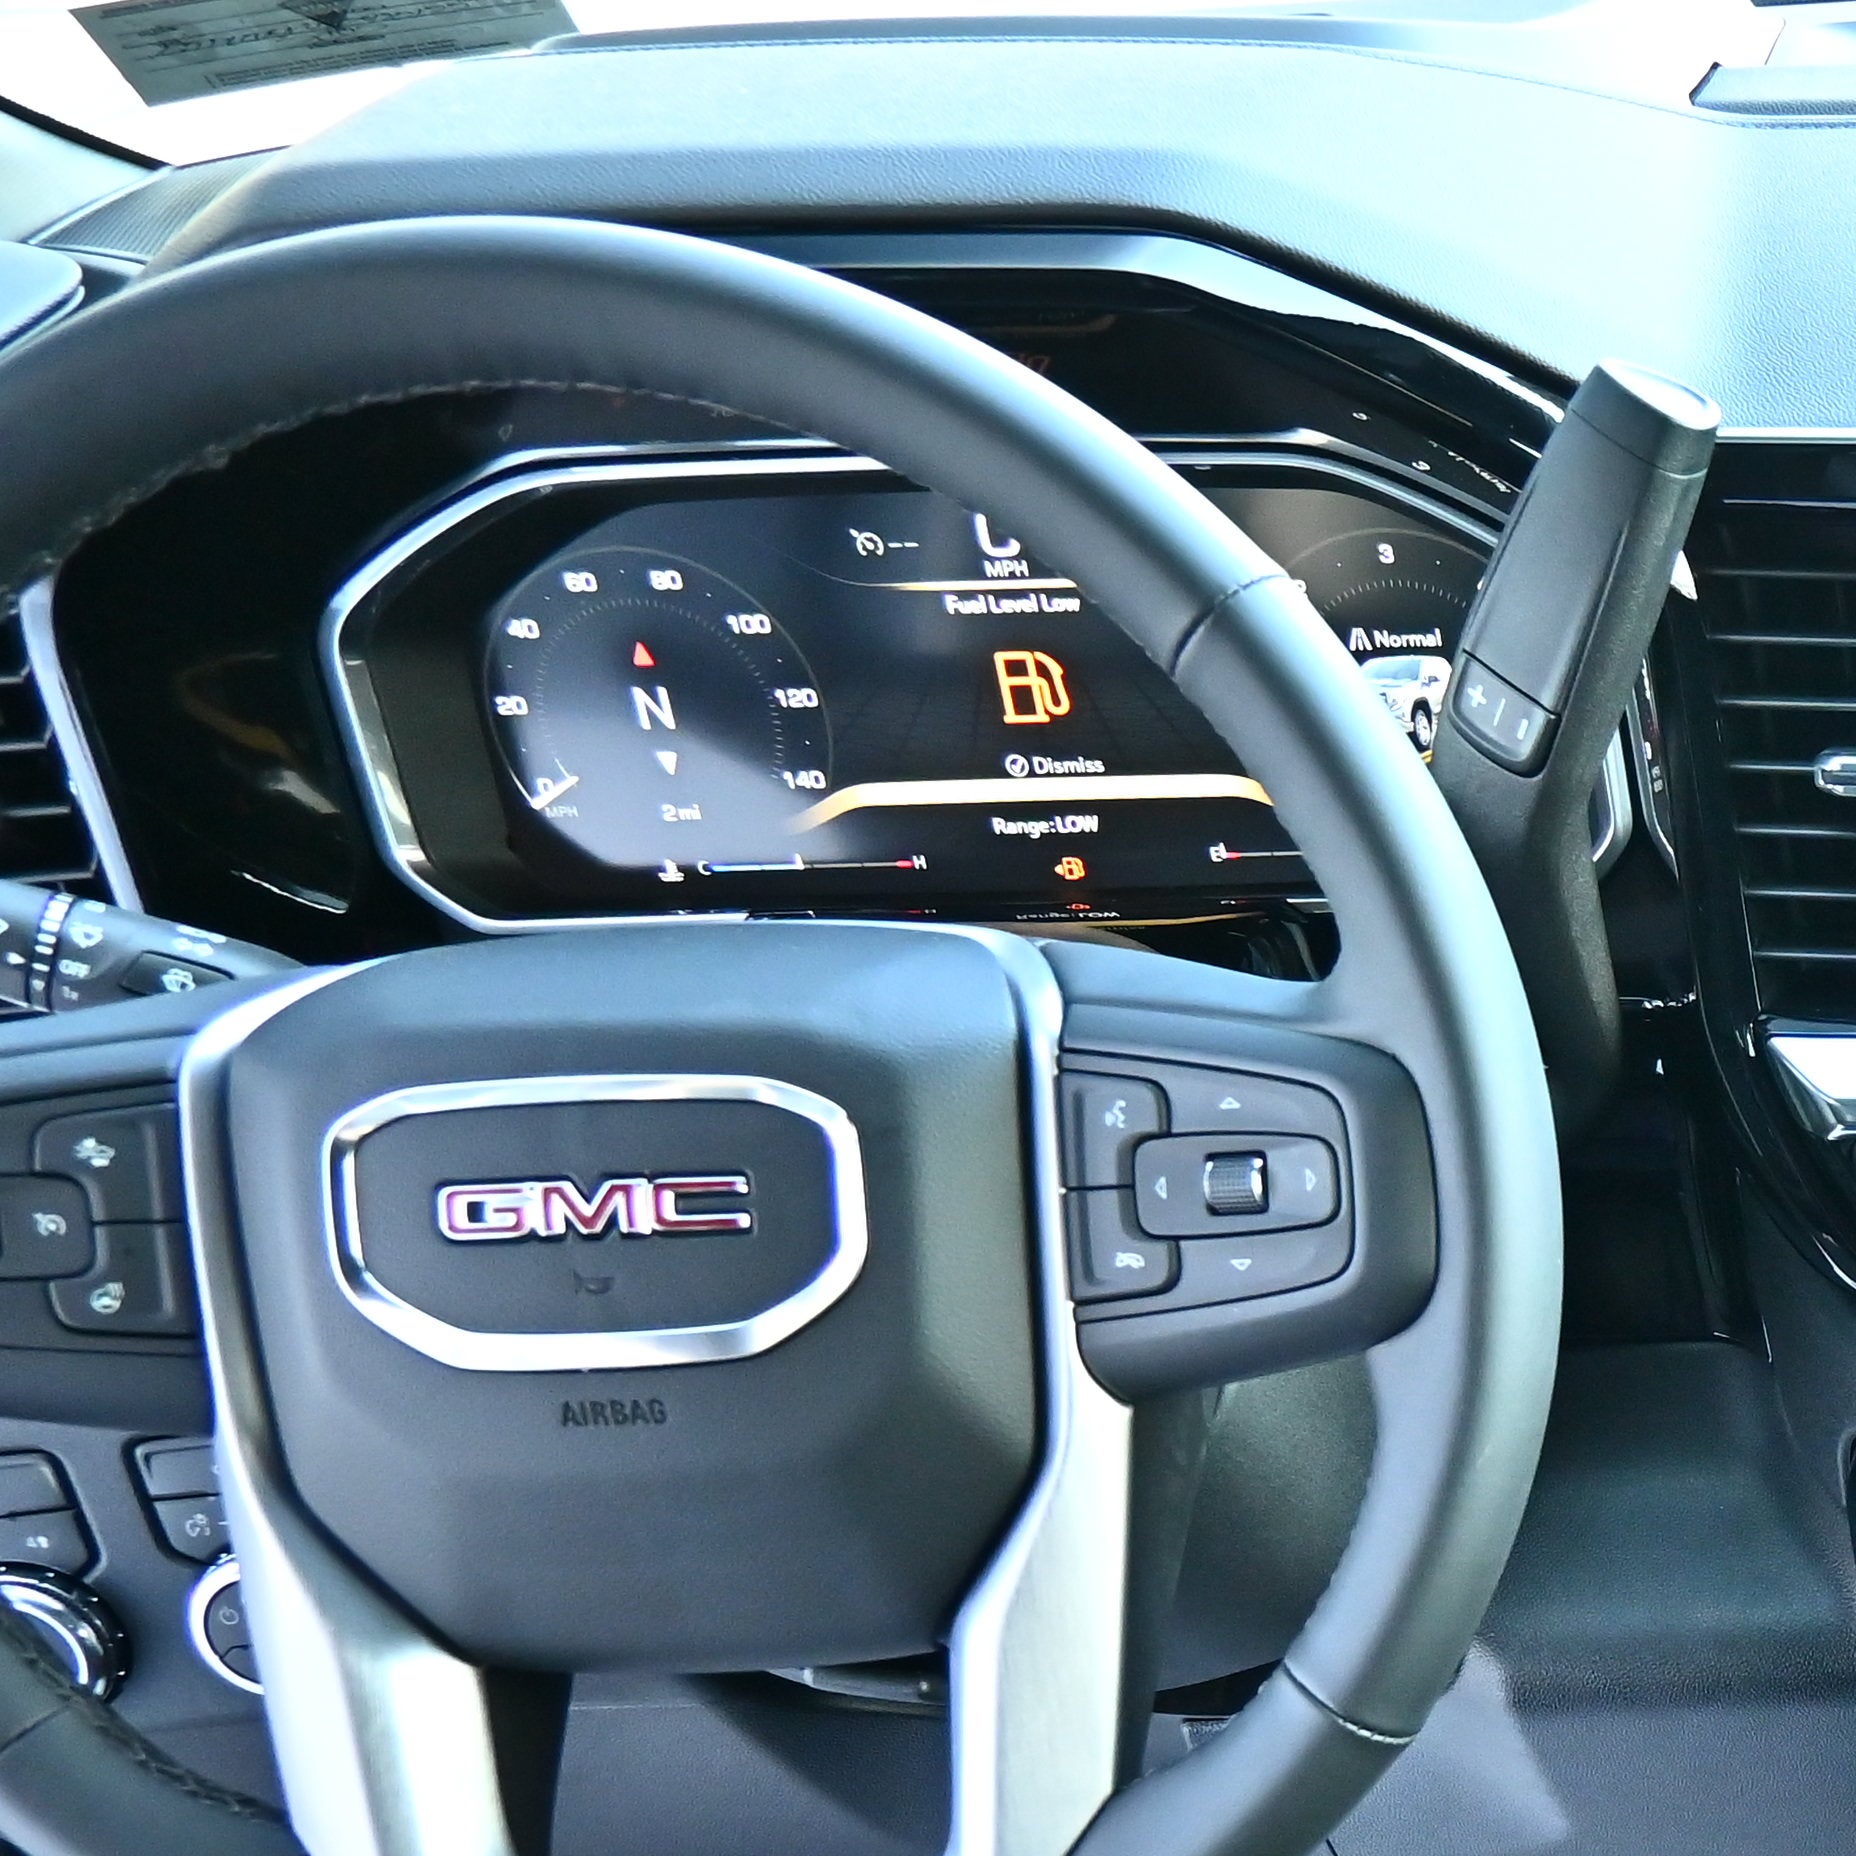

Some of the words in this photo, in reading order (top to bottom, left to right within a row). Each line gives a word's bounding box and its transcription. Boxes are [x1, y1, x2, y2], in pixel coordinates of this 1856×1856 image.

[1378, 543, 1395, 564] 3
[984, 560, 1029, 577] MPH
[563, 573, 598, 593] 60
[649, 571, 684, 592] 80
[944, 594, 988, 615] Fuel
[988, 593, 1040, 614] Level
[1039, 593, 1080, 613] Low
[506, 619, 540, 639] 40
[726, 613, 772, 636] 100
[1373, 628, 1442, 648] Normal
[495, 696, 528, 716] 20
[631, 686, 677, 731] N
[774, 688, 819, 709] 120
[1032, 754, 1105, 777] Dismiss
[783, 770, 826, 791] 140
[546, 806, 579, 818] MPH
[437, 1175, 752, 1241] GMC
[560, 1399, 667, 1428] AIRBAG
